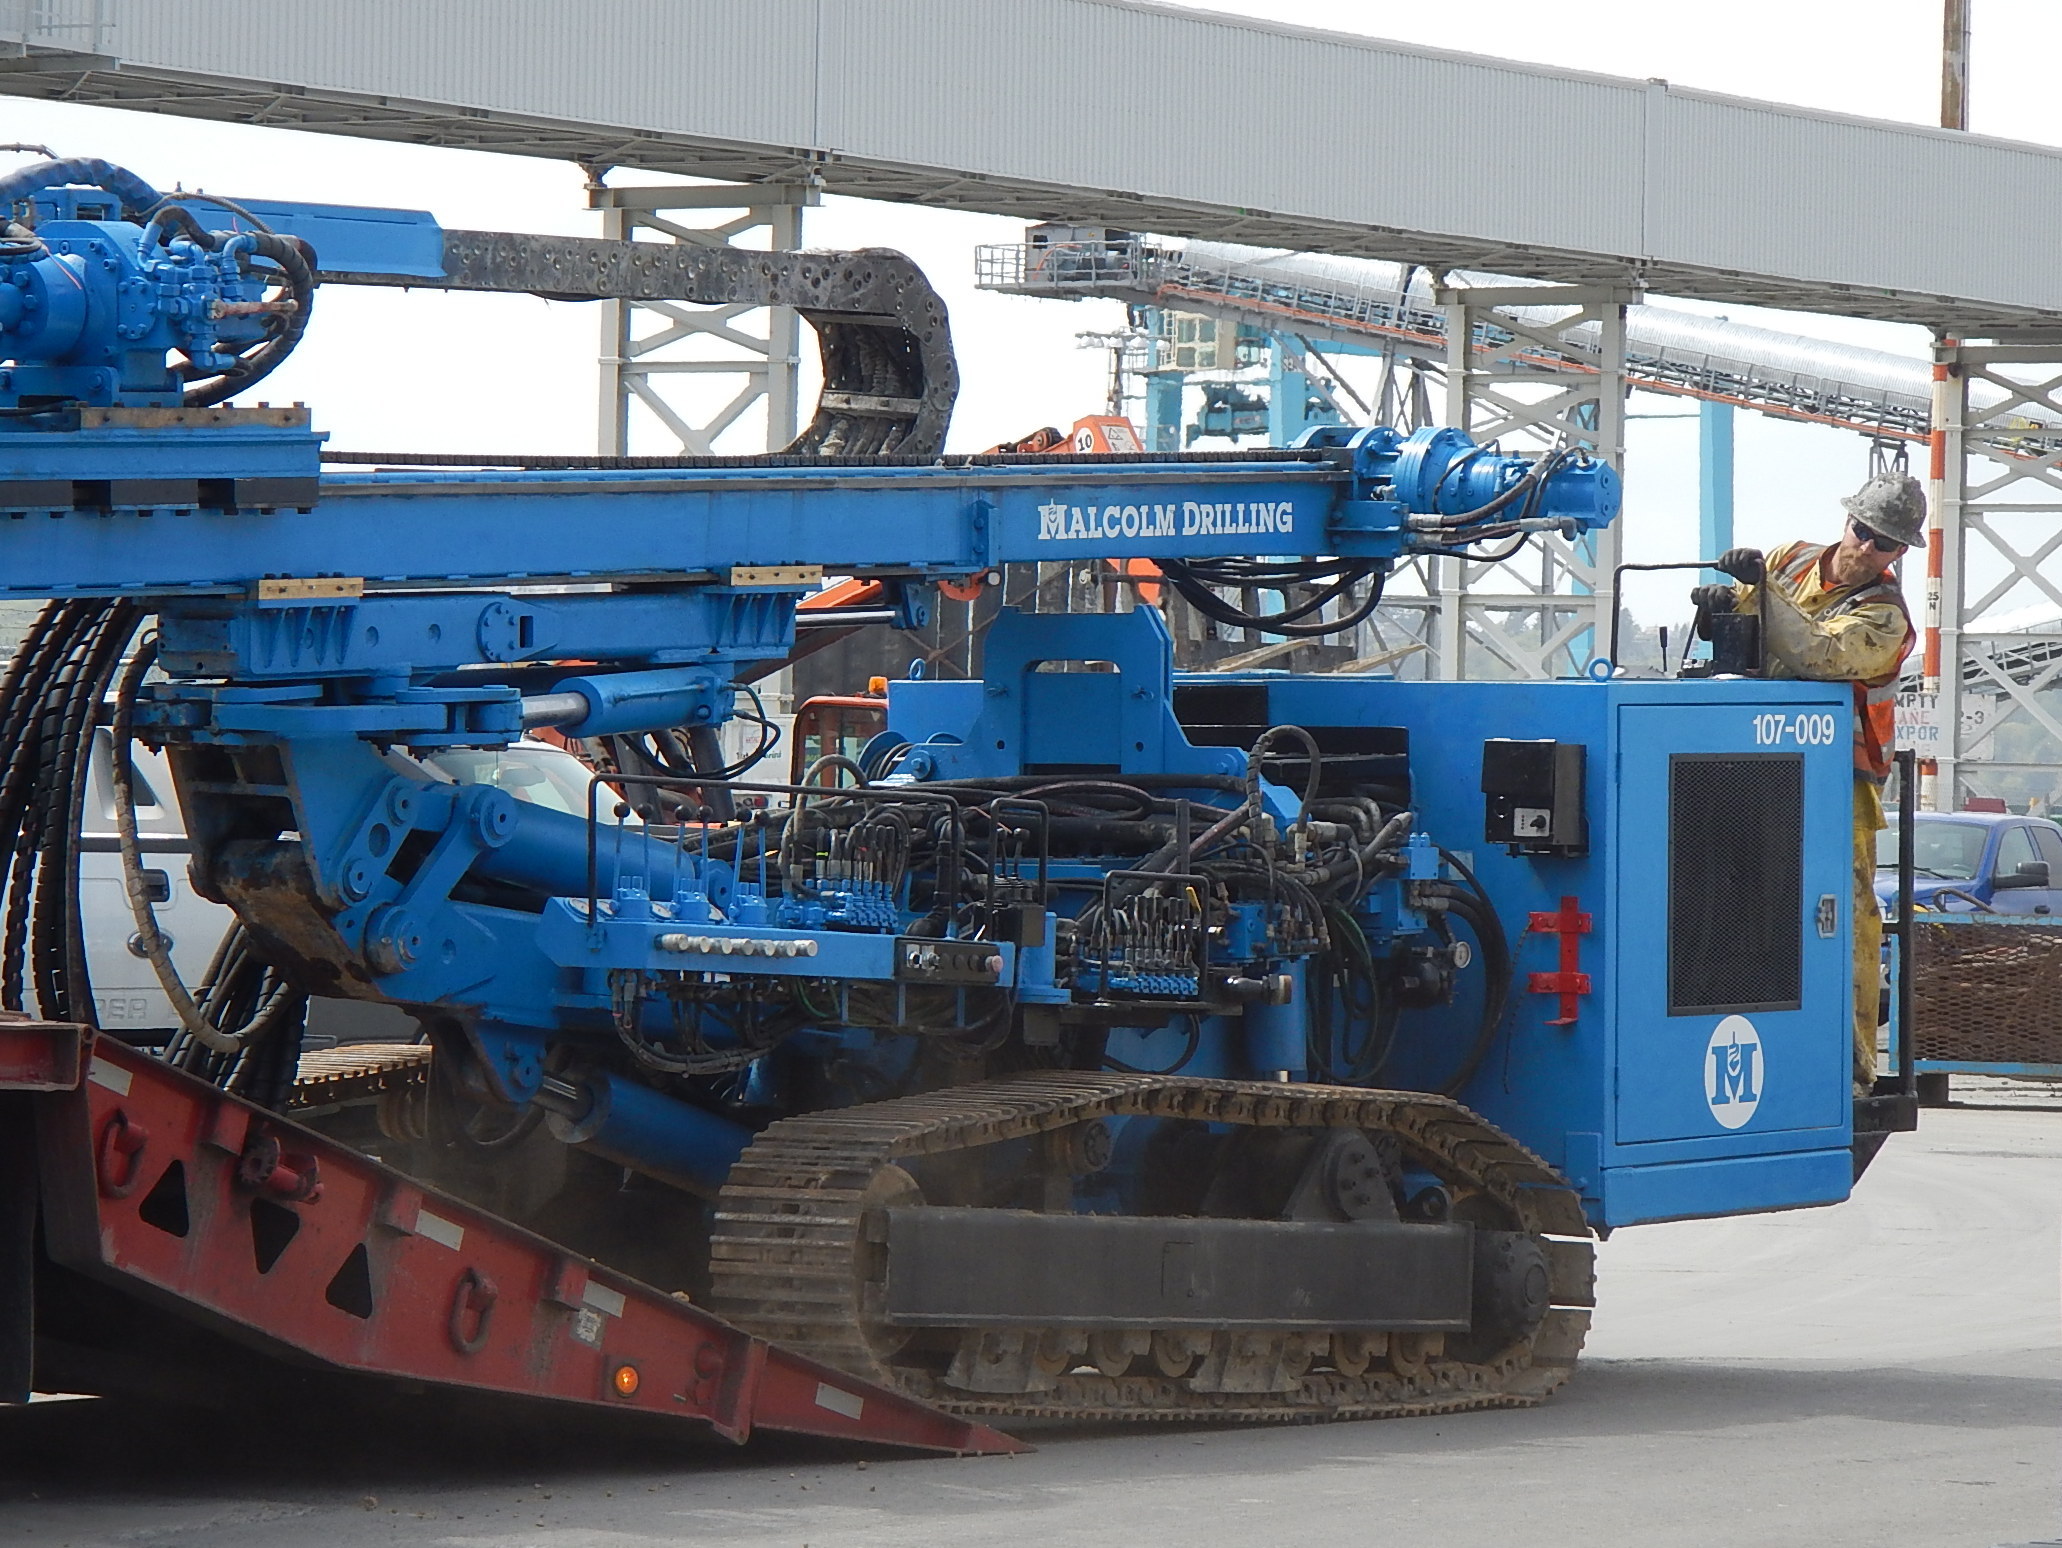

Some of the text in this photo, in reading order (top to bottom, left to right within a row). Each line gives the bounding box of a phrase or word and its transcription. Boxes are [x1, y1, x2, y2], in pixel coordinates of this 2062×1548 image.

[1077, 434, 1092, 452] 10
[1037, 500, 1293, 540] MALCOLM DRILLING
[1894, 693, 1939, 709] MPTY
[1895, 710, 1931, 725] ANE
[1752, 713, 1835, 745] 107-009
[1896, 725, 1939, 741] XPOR
